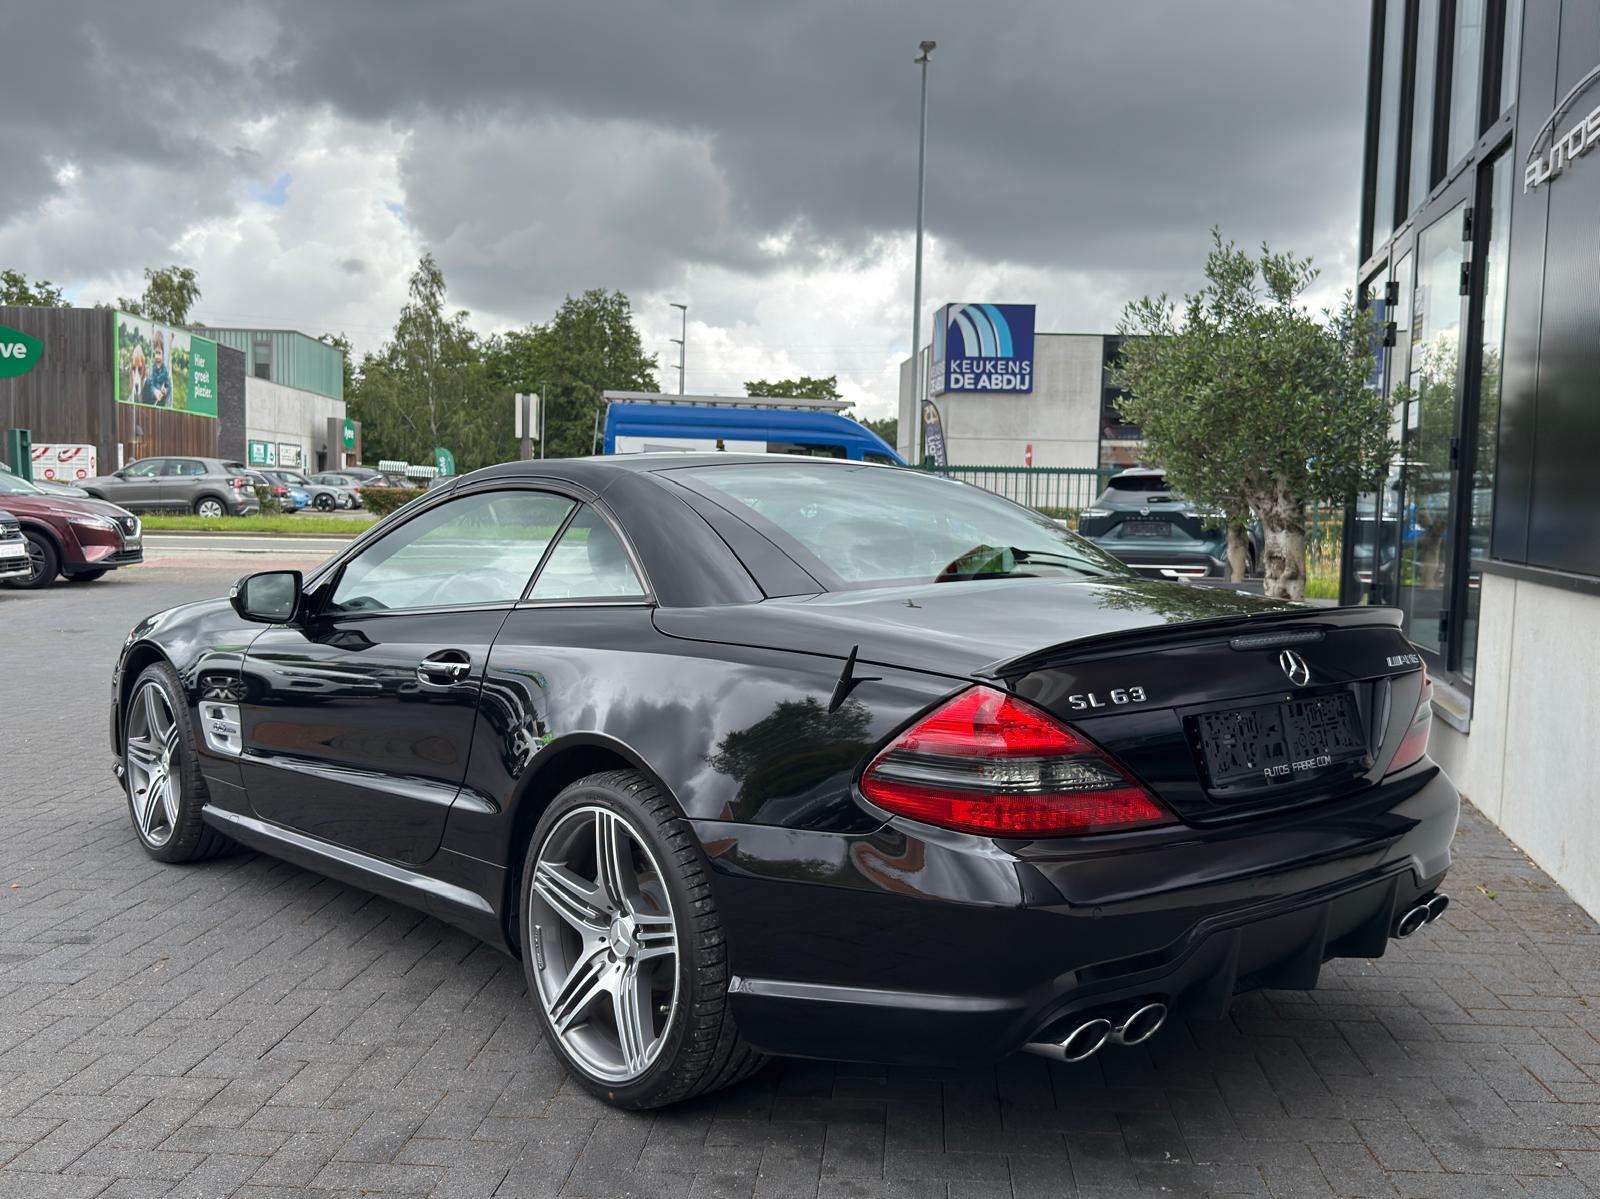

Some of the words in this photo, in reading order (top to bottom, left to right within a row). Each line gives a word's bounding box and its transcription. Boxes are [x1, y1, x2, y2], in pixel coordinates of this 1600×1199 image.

[1524, 105, 1600, 194] AUTOS
[0, 342, 27, 359] ve
[194, 352, 206, 367] Hier
[950, 359, 1031, 374] KEUKENS
[950, 374, 975, 389] DE
[977, 374, 1030, 390] ABDIJ
[1068, 692, 1106, 710] SL
[1110, 686, 1147, 704] 63
[1263, 764, 1290, 778] AUTOS
